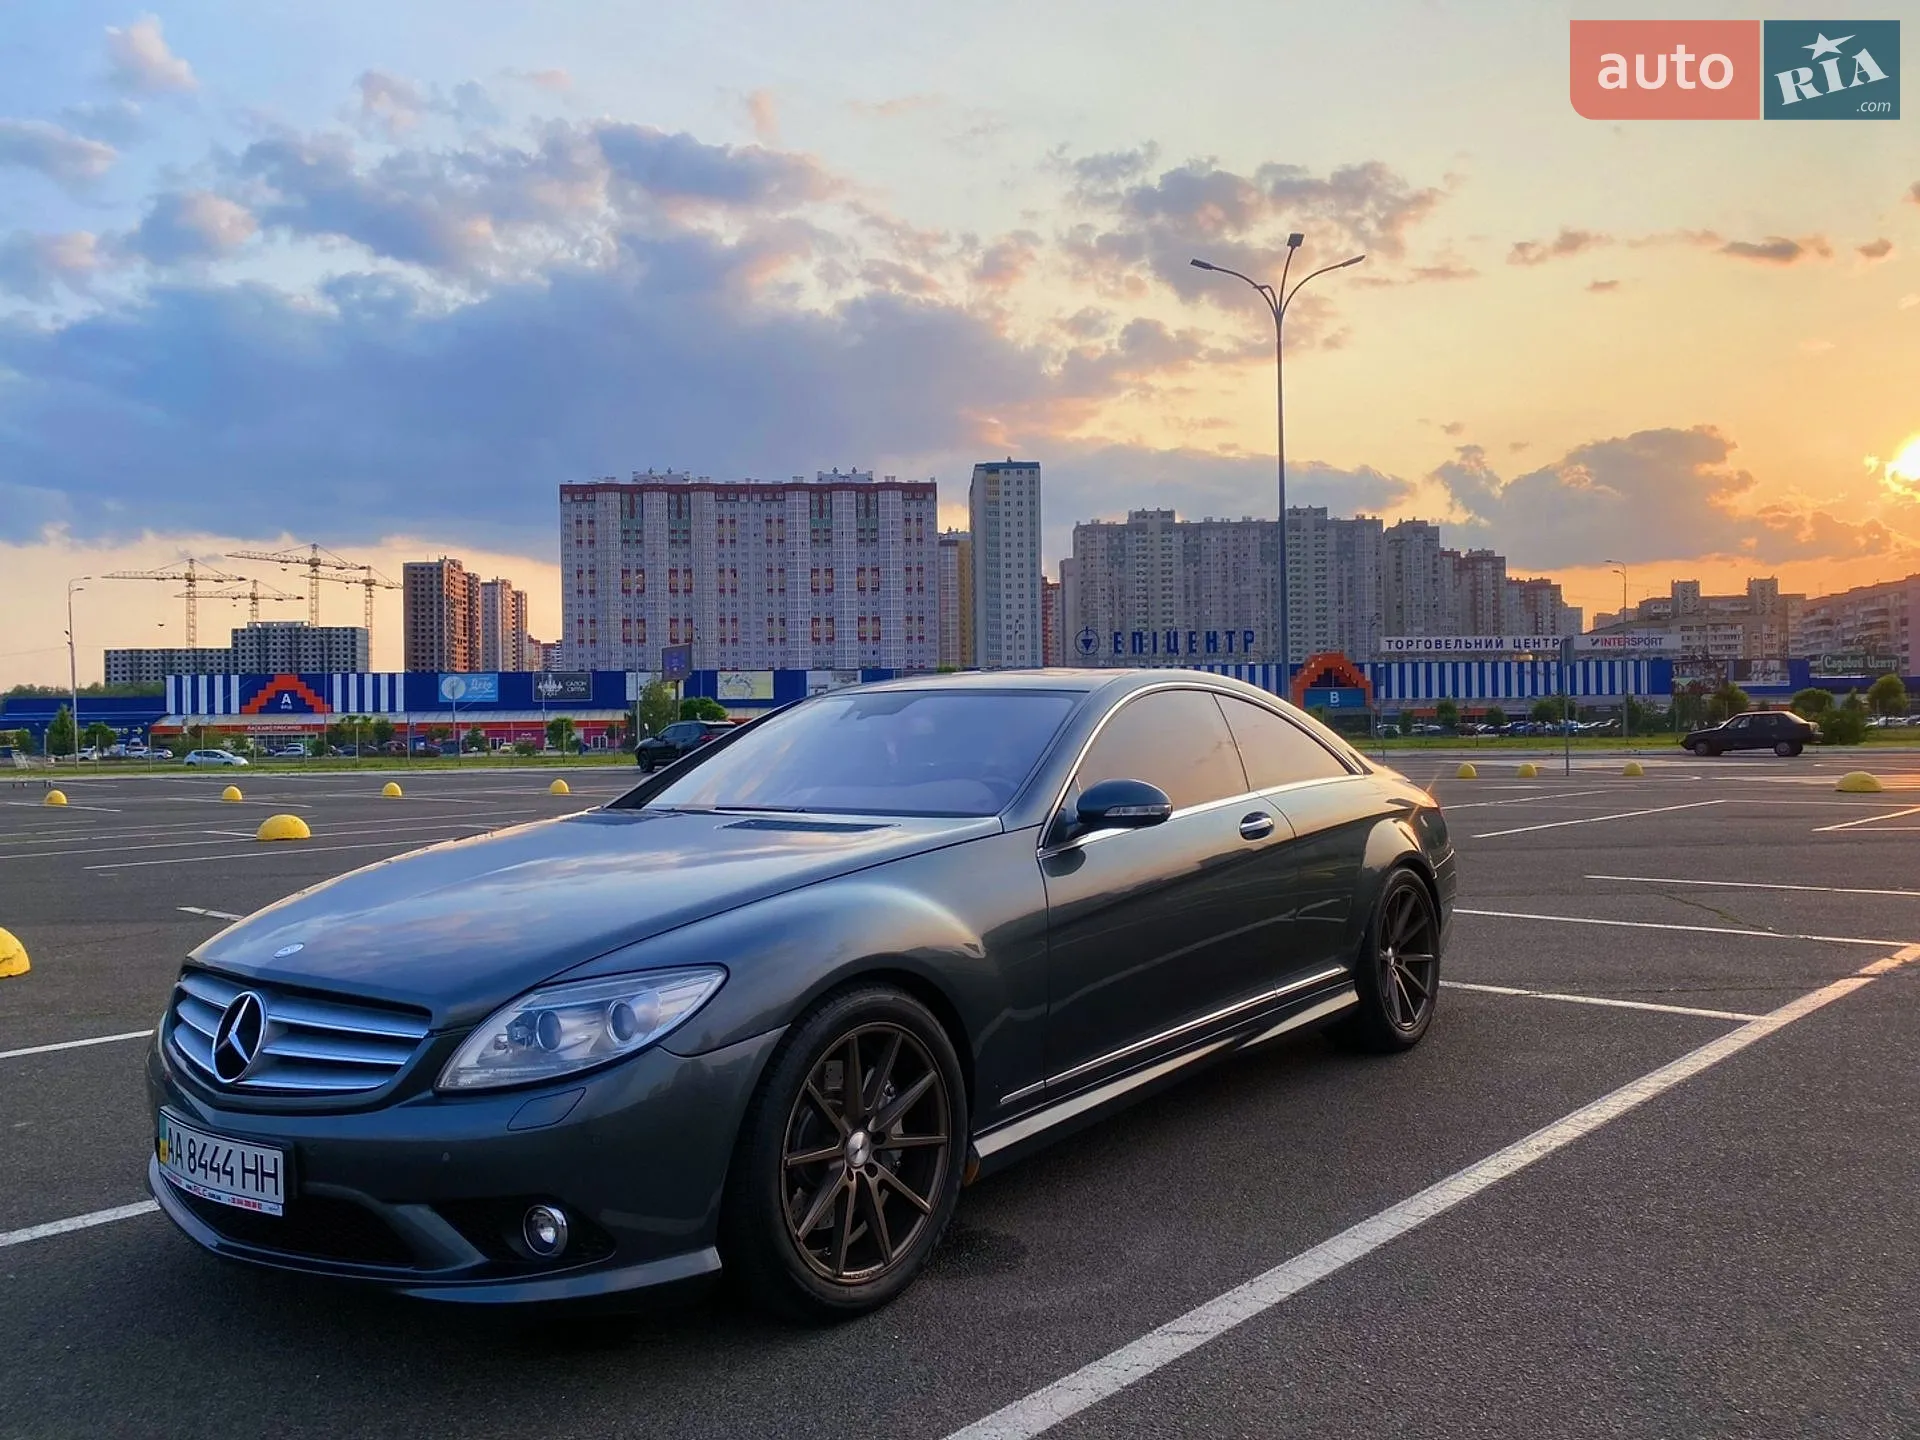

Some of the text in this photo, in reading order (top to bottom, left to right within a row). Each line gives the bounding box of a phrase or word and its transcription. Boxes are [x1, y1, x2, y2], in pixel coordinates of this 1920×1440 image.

[1113, 630, 1256, 655] ЕПІЦЕНТР
[1386, 636, 1560, 650] ТОРГОВЕЛЬНИЙ ЦЕНТР
[1601, 637, 1665, 647] INTERSPORT
[168, 1127, 279, 1196] AA 8444 HH
